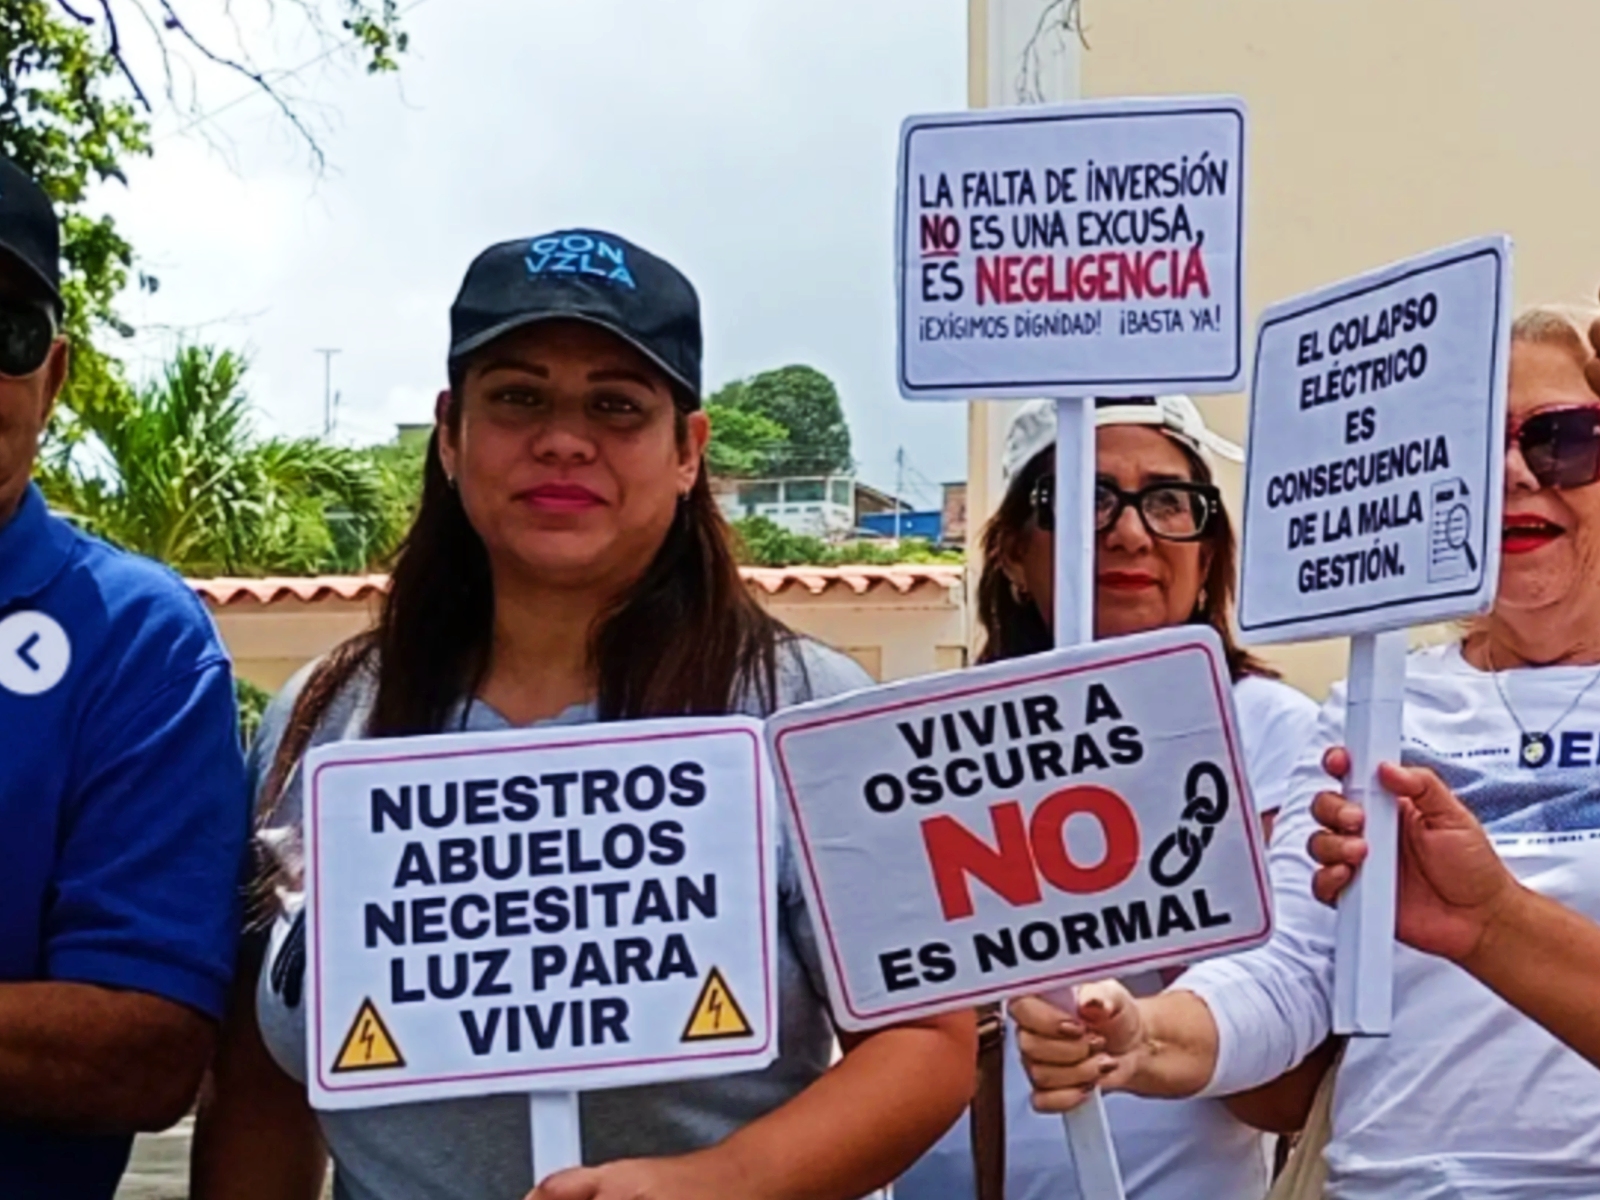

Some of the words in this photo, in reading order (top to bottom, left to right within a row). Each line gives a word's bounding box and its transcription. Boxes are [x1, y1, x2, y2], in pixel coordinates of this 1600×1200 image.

[920, 172, 953, 209] LA
[962, 168, 1036, 208] FALTA
[1045, 167, 1078, 204] DE
[532, 234, 623, 264] CON
[920, 213, 961, 251] NO
[970, 215, 1004, 250] ES
[1012, 210, 1068, 249] UNA
[1077, 204, 1205, 249] EXCUSA,
[524, 252, 636, 289] VZLA
[922, 260, 964, 302] ES
[976, 247, 1210, 306] NEGLIGENCIA
[1120, 308, 1184, 336] ¡BASTA
[1190, 304, 1221, 332] YA!
[1296, 330, 1324, 366] EL
[1328, 293, 1438, 357] COLAPSO
[1300, 343, 1428, 411] ELÉCTRICO
[1345, 407, 1375, 444] ES
[1266, 435, 1450, 508] CONSECUENCIA
[1288, 513, 1319, 549] DE
[1322, 507, 1352, 543] LA
[1358, 491, 1423, 535] MALA
[1298, 537, 1405, 593] GESTIÓN.
[897, 694, 1062, 760] VIVIR
[1084, 683, 1123, 725] A
[1518, 731, 1600, 769] DE
[370, 761, 706, 833] NUESTROS
[863, 725, 1144, 814] OSCURAS
[393, 820, 686, 887] ABUELOS
[920, 784, 1140, 922] NO
[364, 873, 717, 948] NECESITAN
[878, 943, 957, 993] ES
[973, 888, 1231, 973] NORMAL
[390, 949, 511, 1004] LUZ
[532, 933, 698, 991] PARA
[459, 997, 630, 1056] VIVIR
